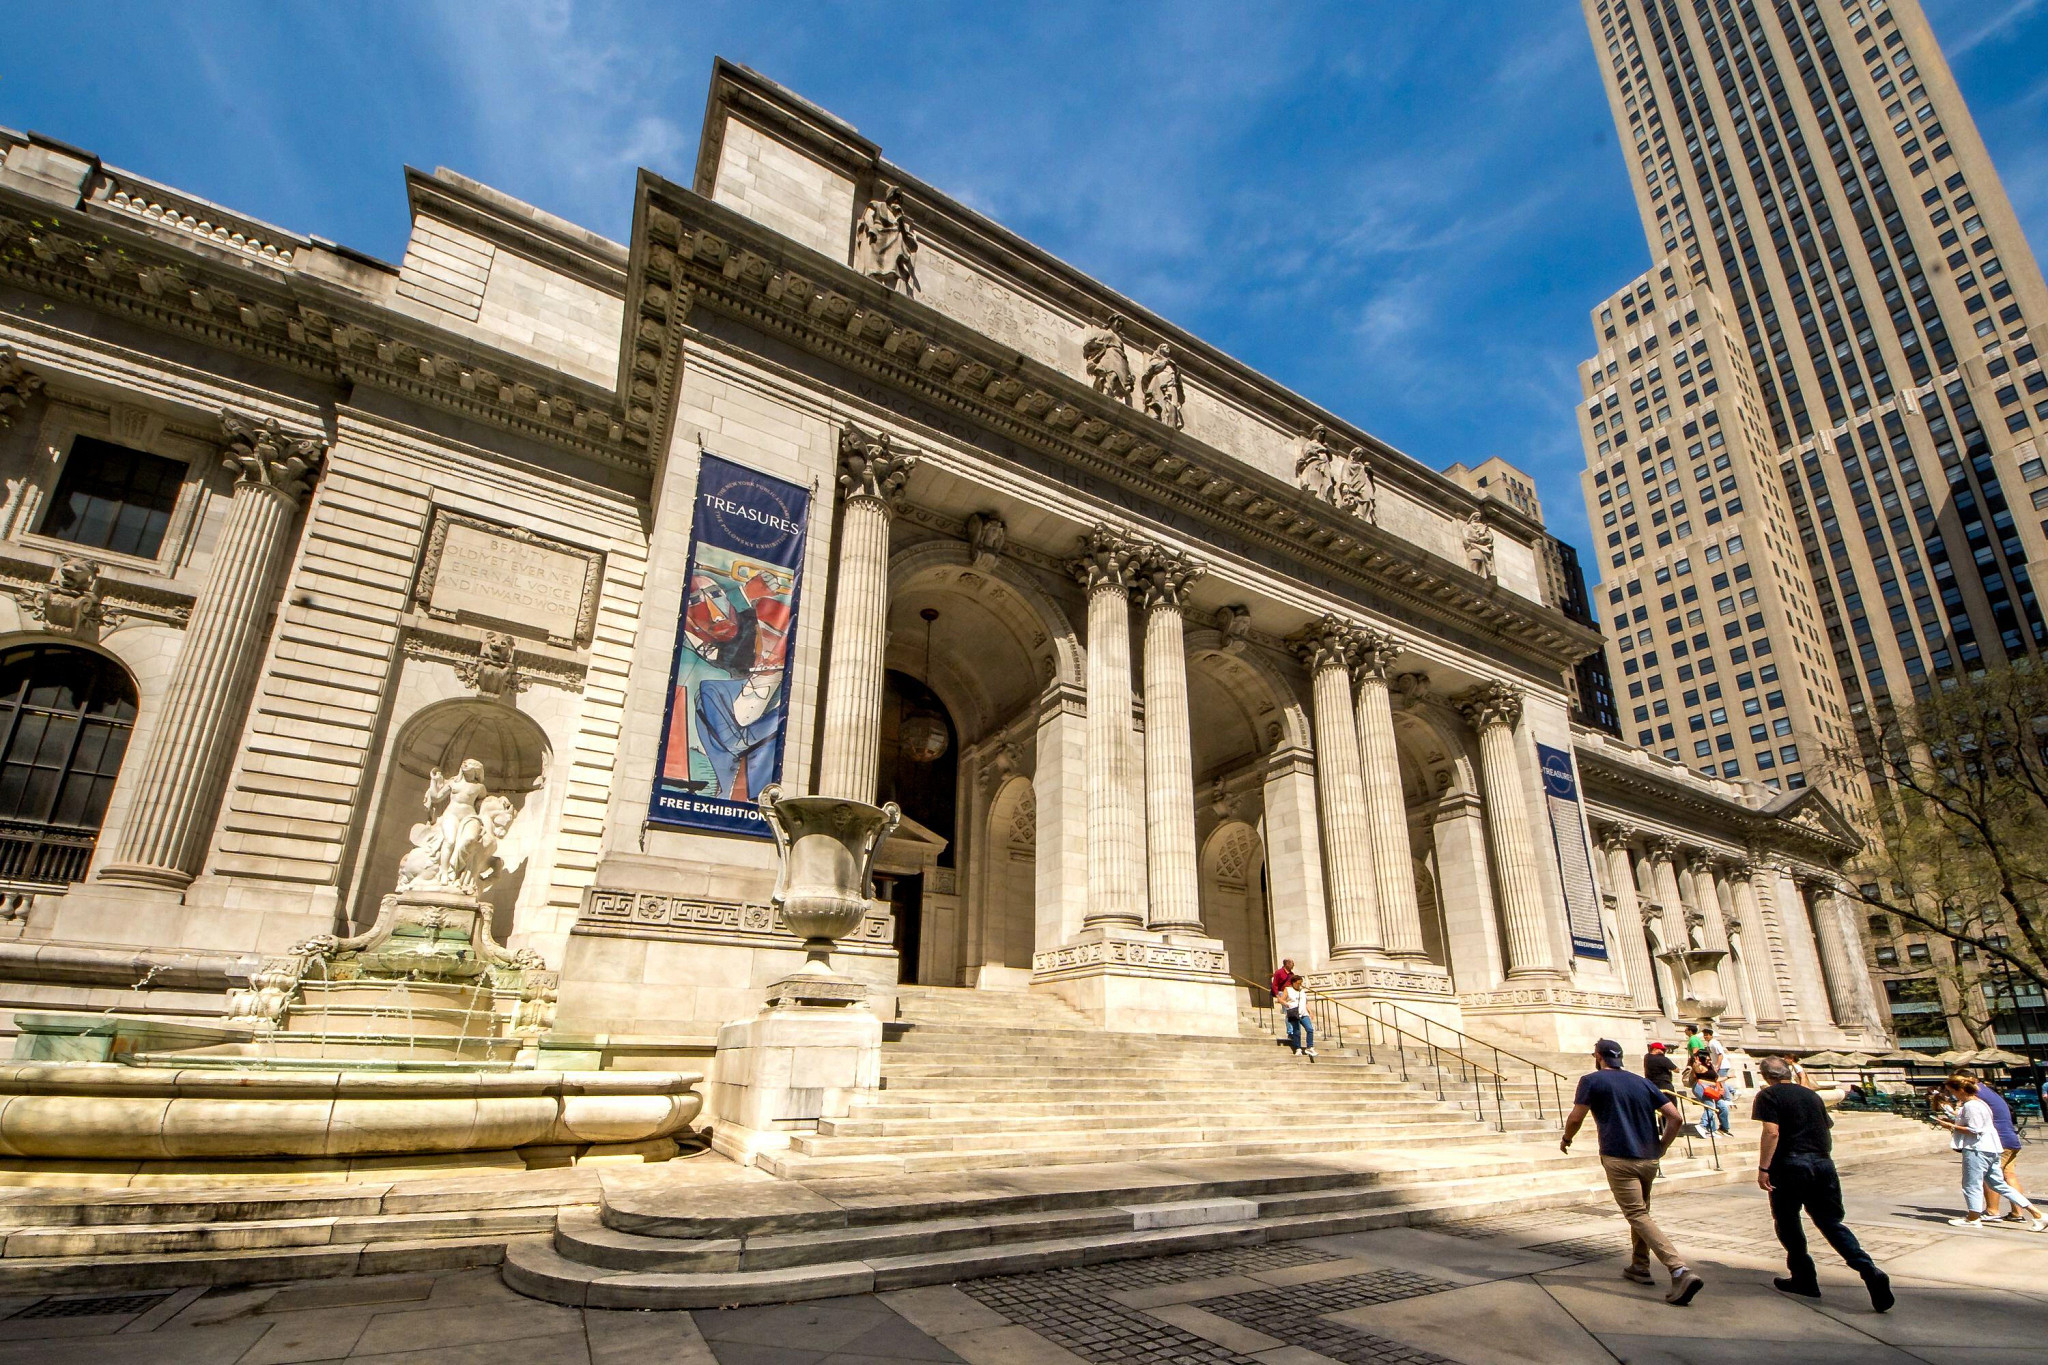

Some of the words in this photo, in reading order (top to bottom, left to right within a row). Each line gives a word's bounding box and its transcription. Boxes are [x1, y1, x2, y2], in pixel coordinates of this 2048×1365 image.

[928, 252, 954, 275] THE
[966, 275, 1010, 301] ASTOR
[1020, 300, 1076, 333] LIBRARY
[983, 305, 1018, 329] JACOB
[1025, 328, 1056, 348] ASTOR
[704, 494, 799, 535] TREASURES
[490, 540, 549, 563] BEAUTY
[721, 524, 754, 547] POLONSKY
[446, 545, 478, 559] OLD
[479, 553, 508, 566] YET
[511, 561, 545, 577] EVER
[551, 572, 582, 586] NEW
[452, 562, 521, 587] ETERNAL
[528, 581, 571, 599] VOICE
[437, 575, 470, 590] AND
[475, 583, 533, 605] INWARD
[534, 599, 577, 616] WORD
[1543, 767, 1573, 782] TREASURES
[659, 797, 691, 811] FREE
